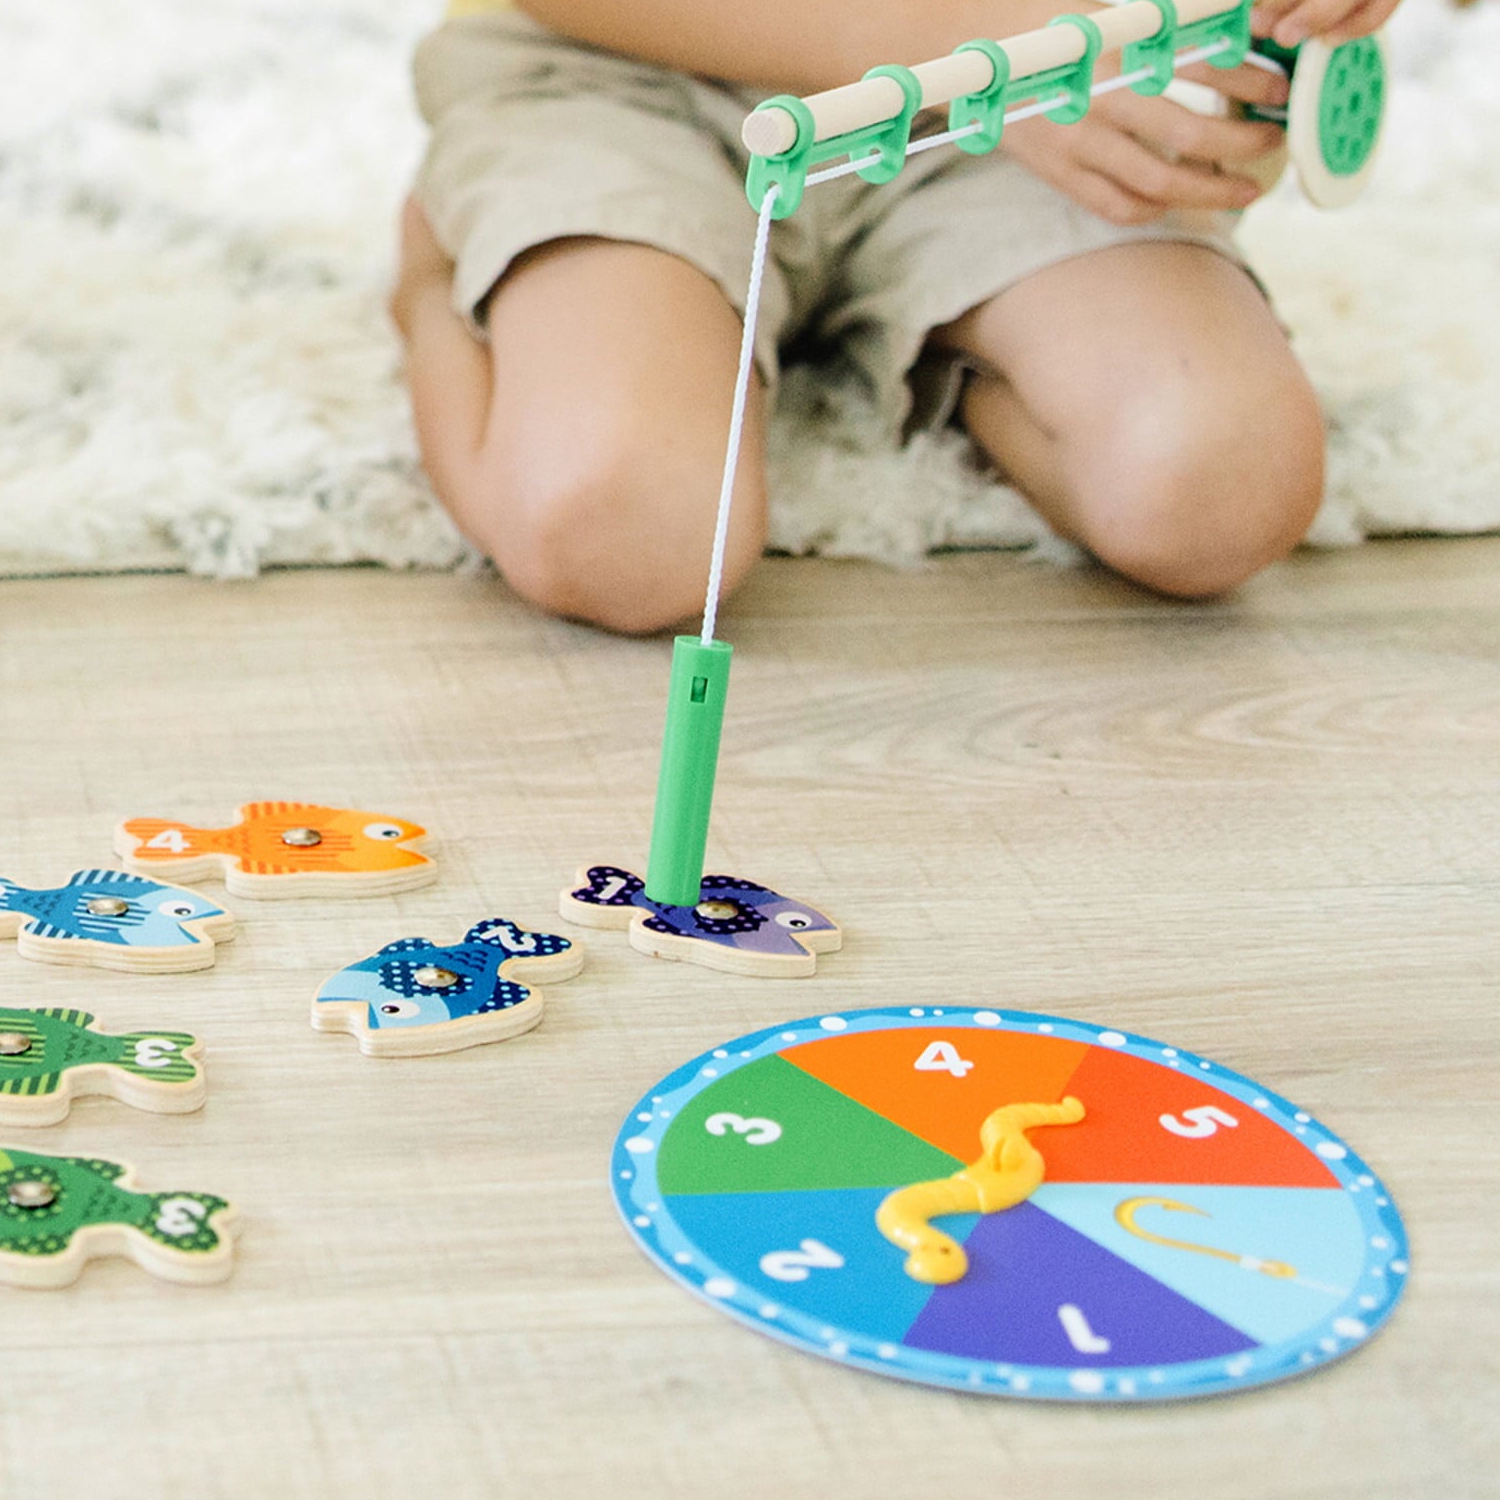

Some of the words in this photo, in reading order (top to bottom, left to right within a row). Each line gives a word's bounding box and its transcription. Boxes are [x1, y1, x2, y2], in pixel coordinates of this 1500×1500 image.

[146, 830, 190, 853] 4
[597, 876, 627, 898] 1
[482, 927, 537, 952] 2
[134, 1039, 177, 1067] 3
[914, 1041, 974, 1077] 4
[705, 1112, 782, 1145] 3
[1159, 1106, 1238, 1138] 5
[158, 1198, 204, 1236] 3
[760, 1239, 844, 1281] 2
[1058, 1304, 1110, 1354] 1
